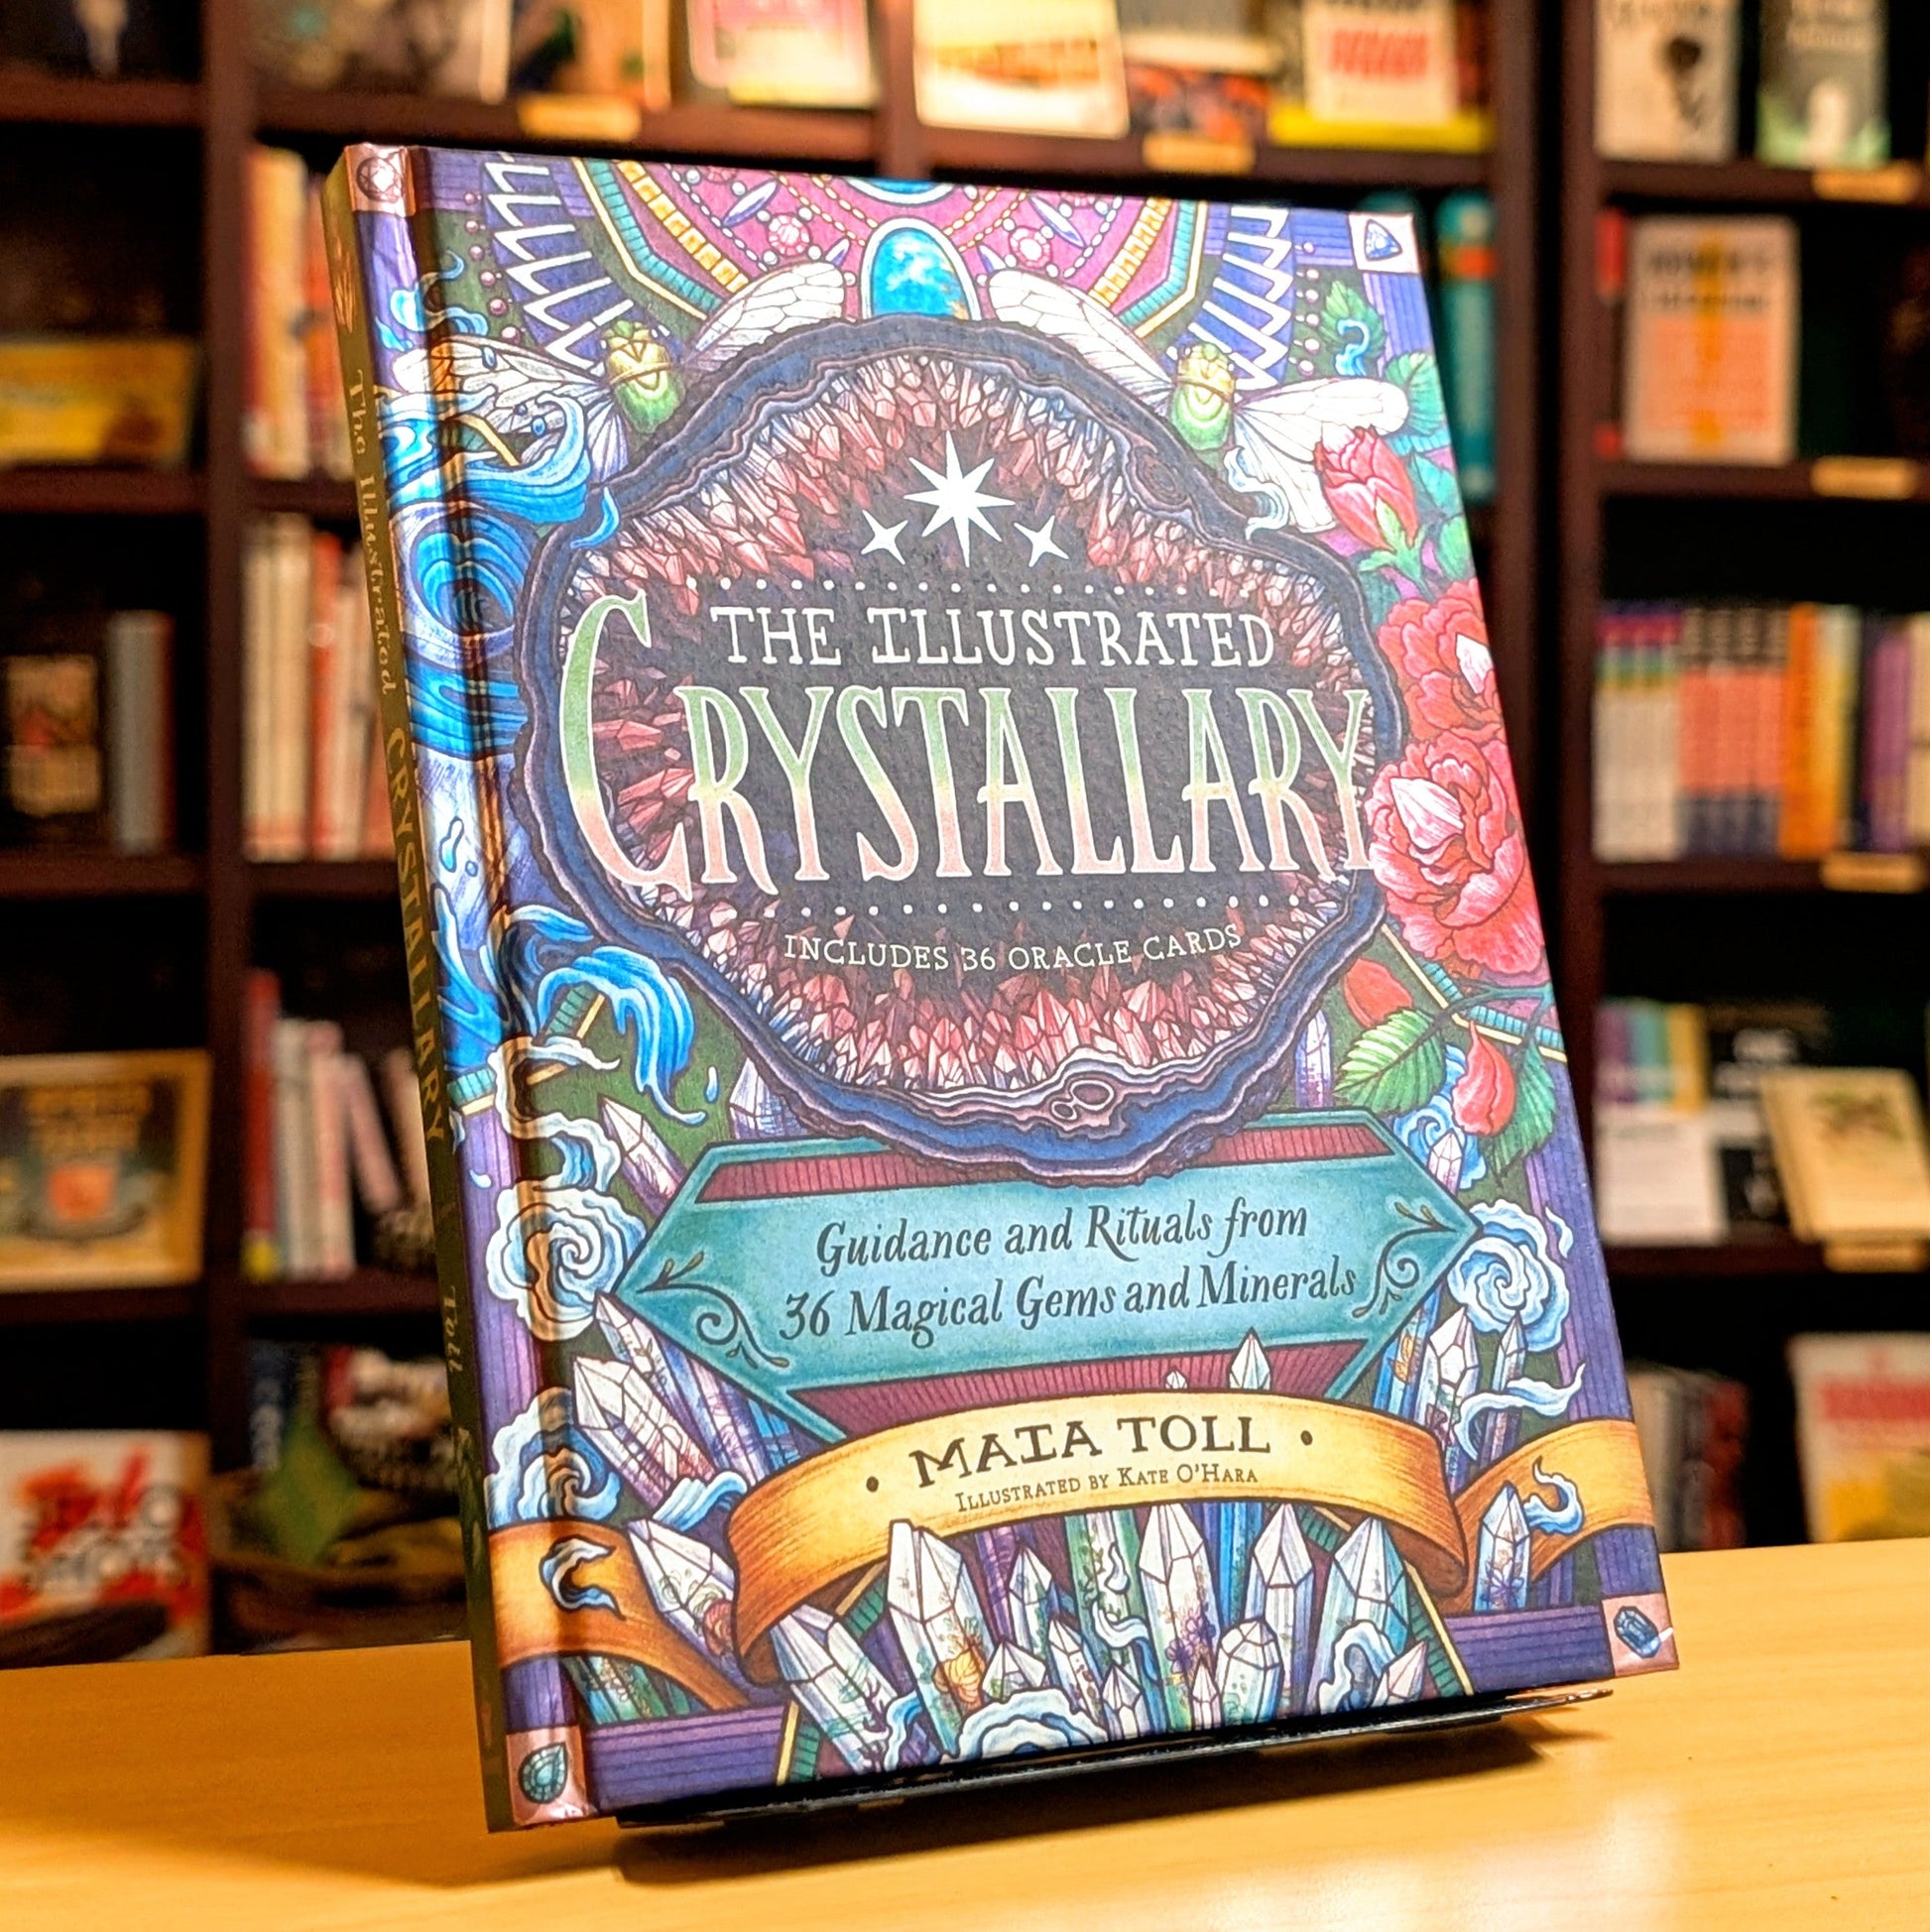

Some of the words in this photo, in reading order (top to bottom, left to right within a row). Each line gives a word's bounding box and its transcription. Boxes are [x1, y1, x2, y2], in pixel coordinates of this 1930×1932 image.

[711, 606, 843, 666] THE
[867, 607, 1275, 668] ILLUSTRATED
[347, 369, 366, 455] The
[358, 474, 398, 695] Illustrated
[386, 727, 445, 1142] CRYSTALLARY
[559, 593, 1373, 902] CRYSTALLARY
[784, 934, 948, 971] INCLUDES
[962, 947, 996, 971] 36
[1008, 939, 1132, 970] ORACLE
[1143, 923, 1244, 959] CARDS
[816, 1218, 992, 1277] Guidance
[1004, 1207, 1073, 1255] and
[1087, 1198, 1212, 1262] Rituals
[1207, 1196, 1307, 1259] from
[779, 1291, 831, 1342] 36
[845, 1278, 1003, 1349] Magical
[1017, 1276, 1116, 1330] Gems
[1123, 1266, 1190, 1312] and
[1195, 1255, 1357, 1307] Minerals
[908, 1420, 1103, 1488] MAIA
[1117, 1415, 1270, 1454] TOLL
